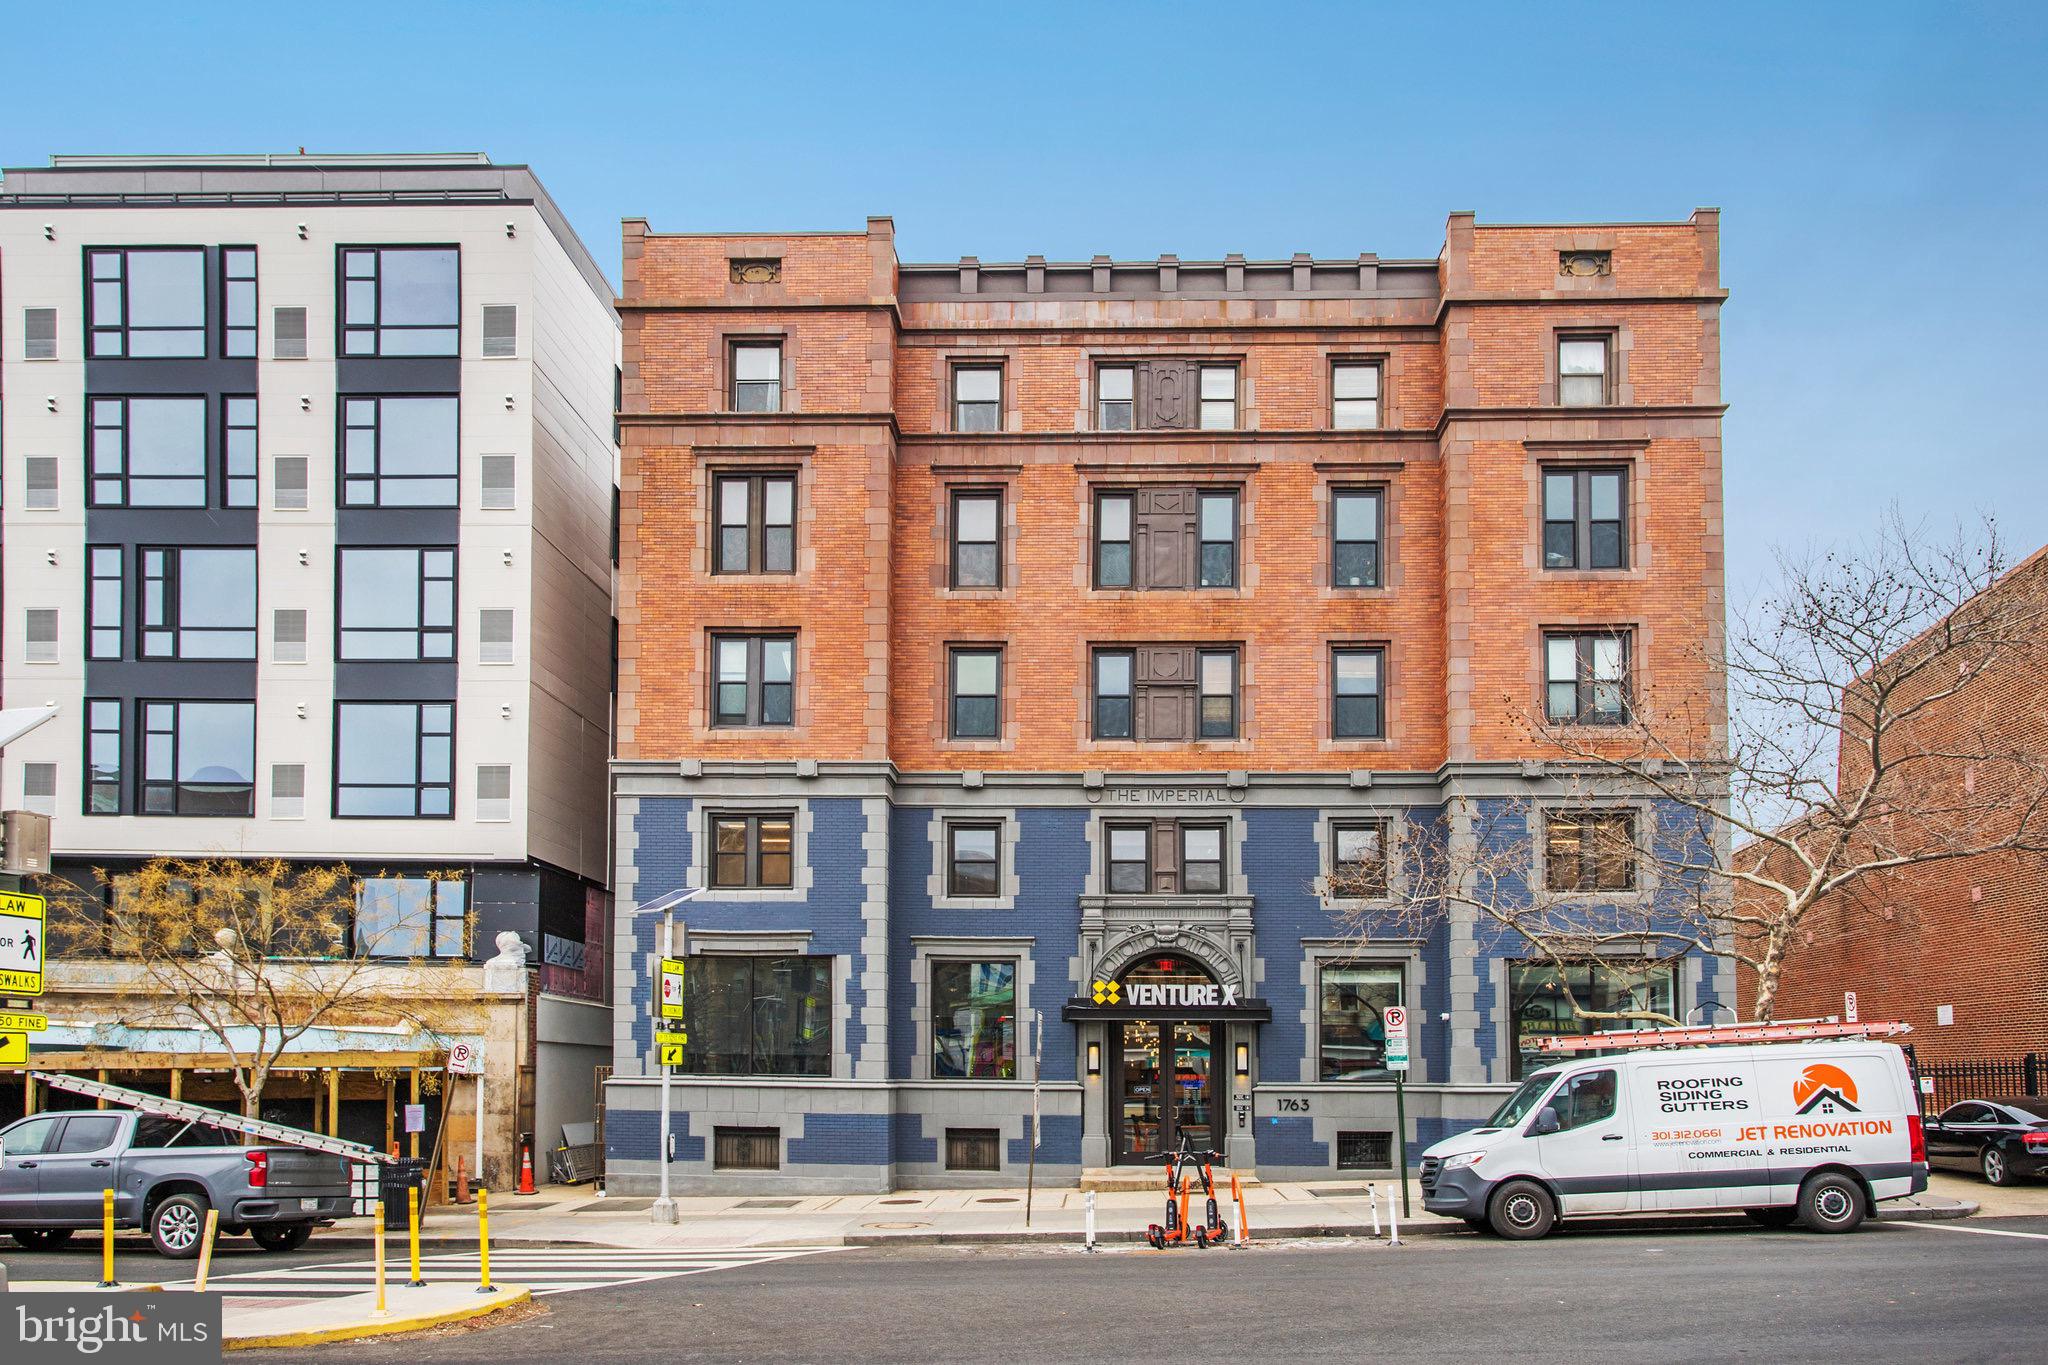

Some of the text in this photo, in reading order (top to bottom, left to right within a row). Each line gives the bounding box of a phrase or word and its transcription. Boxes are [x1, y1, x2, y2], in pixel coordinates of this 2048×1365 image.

[1106, 789, 1226, 802] THE IMPERIAL
[1125, 984, 1238, 1006] VENTURE X
[19, 1017, 42, 1029] FINE
[1657, 1077, 1743, 1090] ROOFING
[1660, 1089, 1723, 1102] SIDING
[1277, 1098, 1310, 1112] 1763
[1661, 1100, 1749, 1113] GUTTERS
[1651, 1129, 1722, 1141] 301.312.0661
[1736, 1120, 1893, 1142] JET RENOVATION
[1688, 1145, 1852, 1159] COMMERCIAL & RESIDENTIAL
